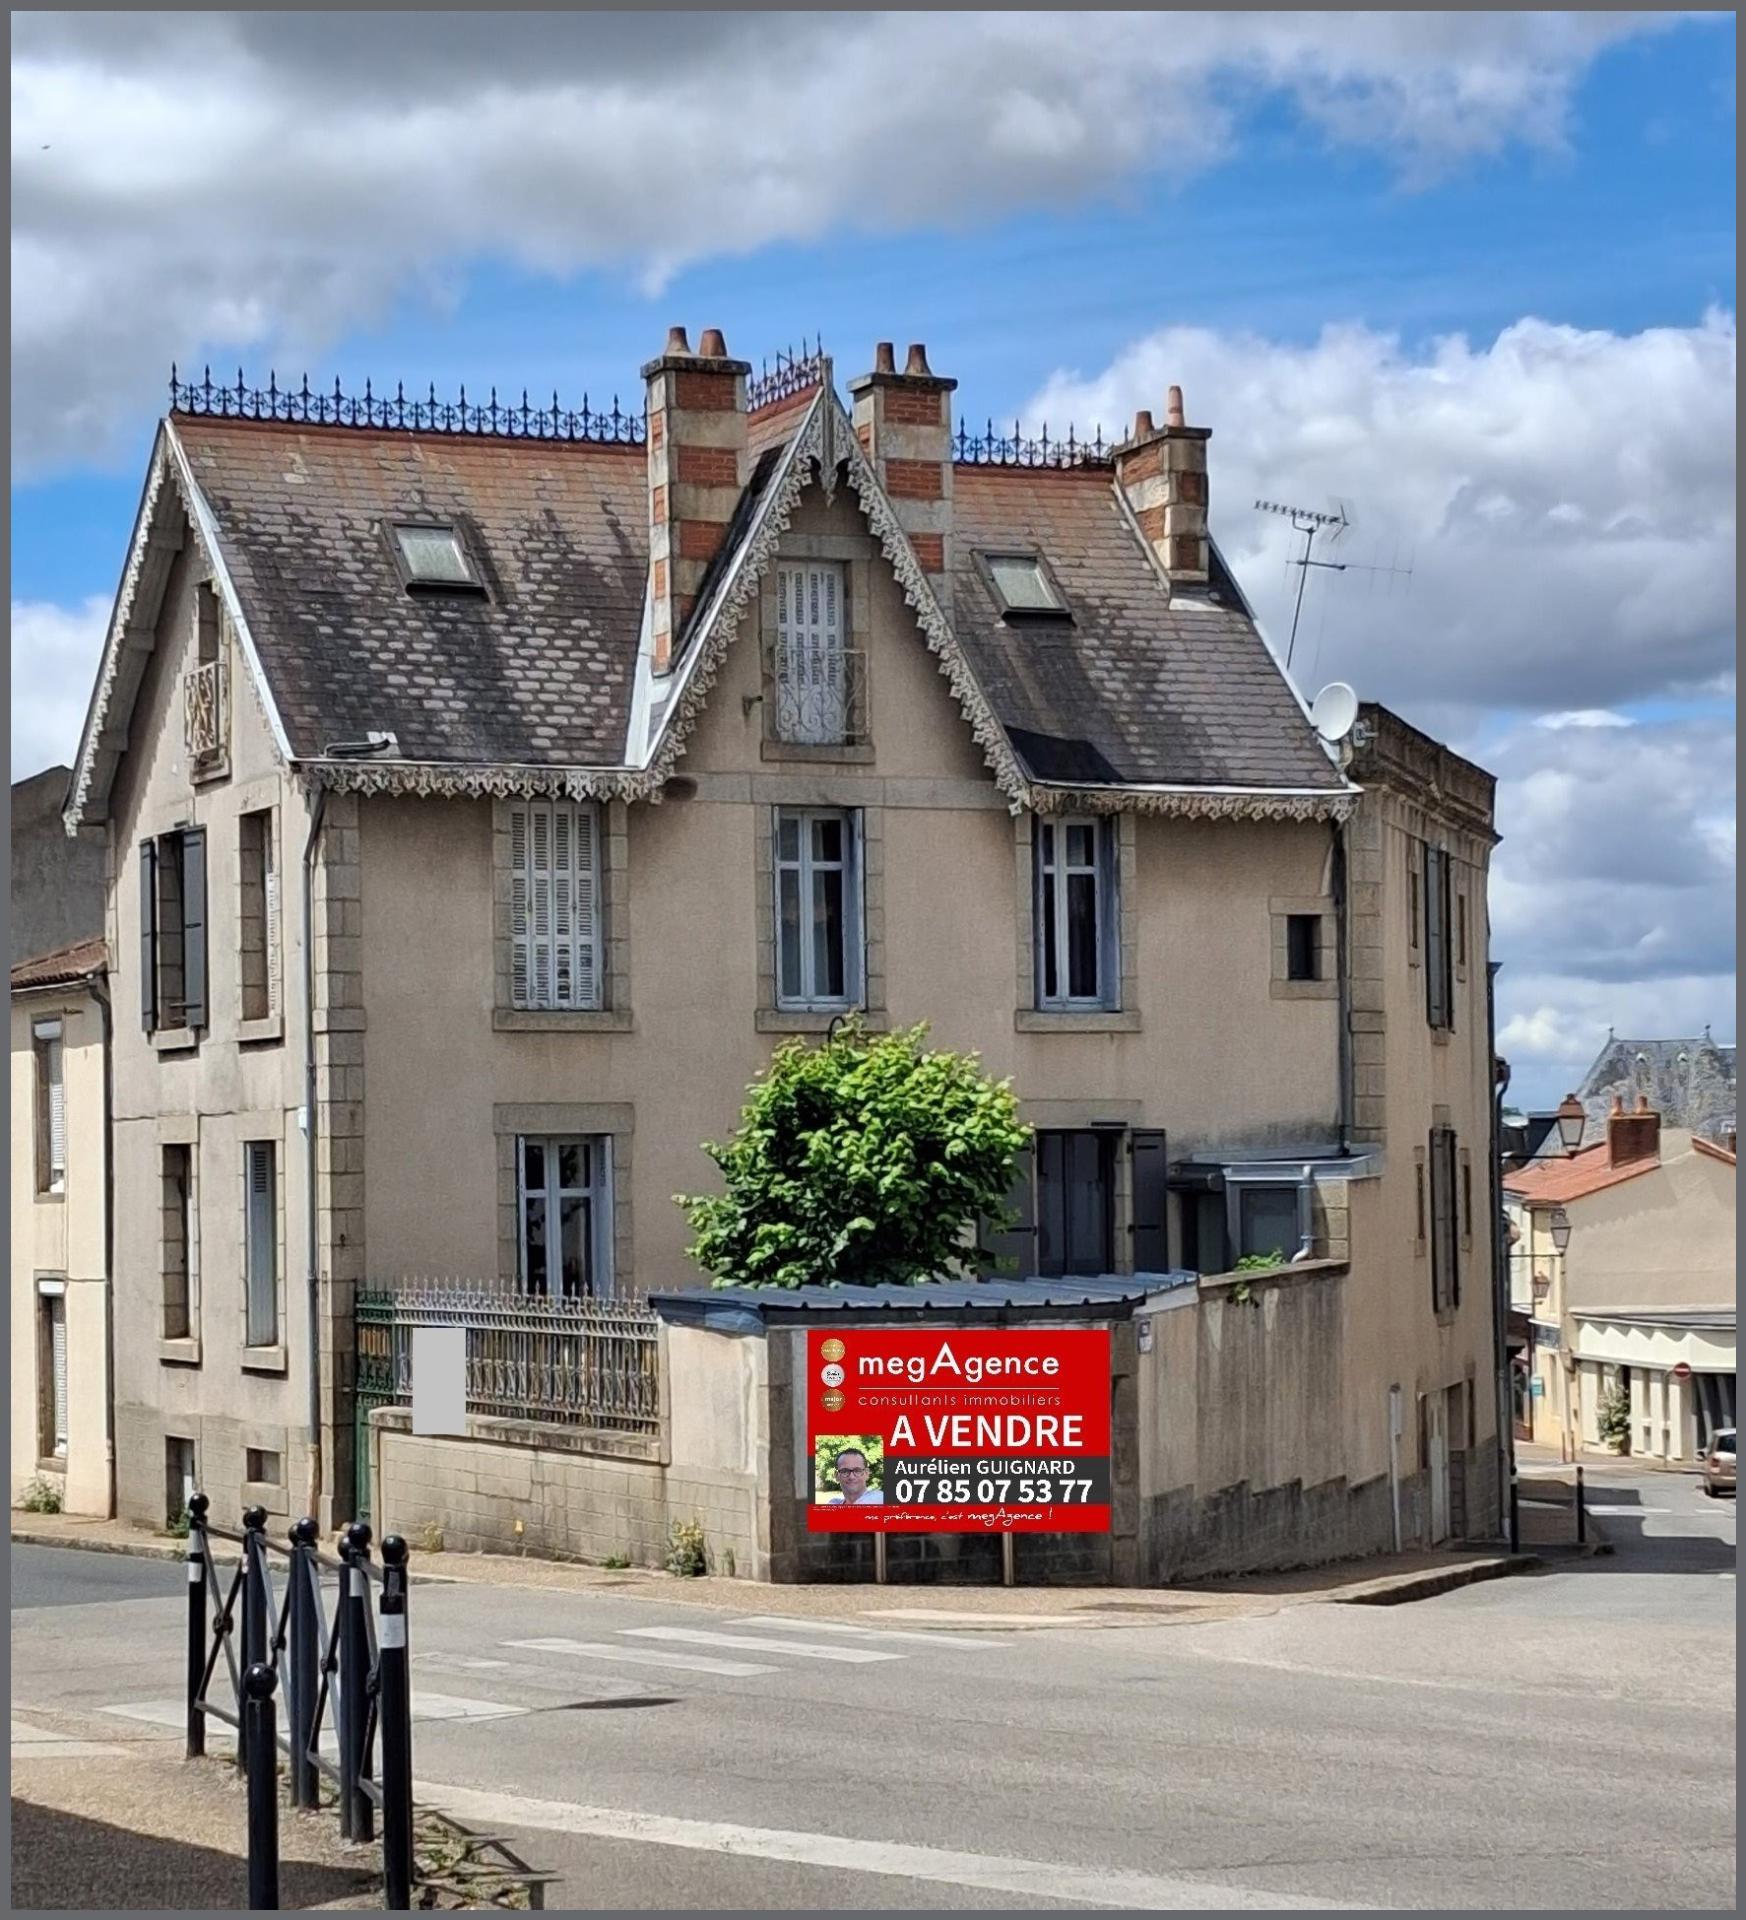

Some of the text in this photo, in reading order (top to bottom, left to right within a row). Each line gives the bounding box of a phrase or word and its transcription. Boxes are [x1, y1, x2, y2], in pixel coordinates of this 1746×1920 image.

[859, 1342, 1060, 1383] megAgence
[963, 1394, 1061, 1406] immobiliers
[889, 1415, 1083, 1447] A VENDRE
[895, 1458, 1075, 1475] Aurélien GUIGNARD
[895, 1479, 1093, 1503] 07 85 07 53 77
[967, 1507, 1043, 1527] megAgence
